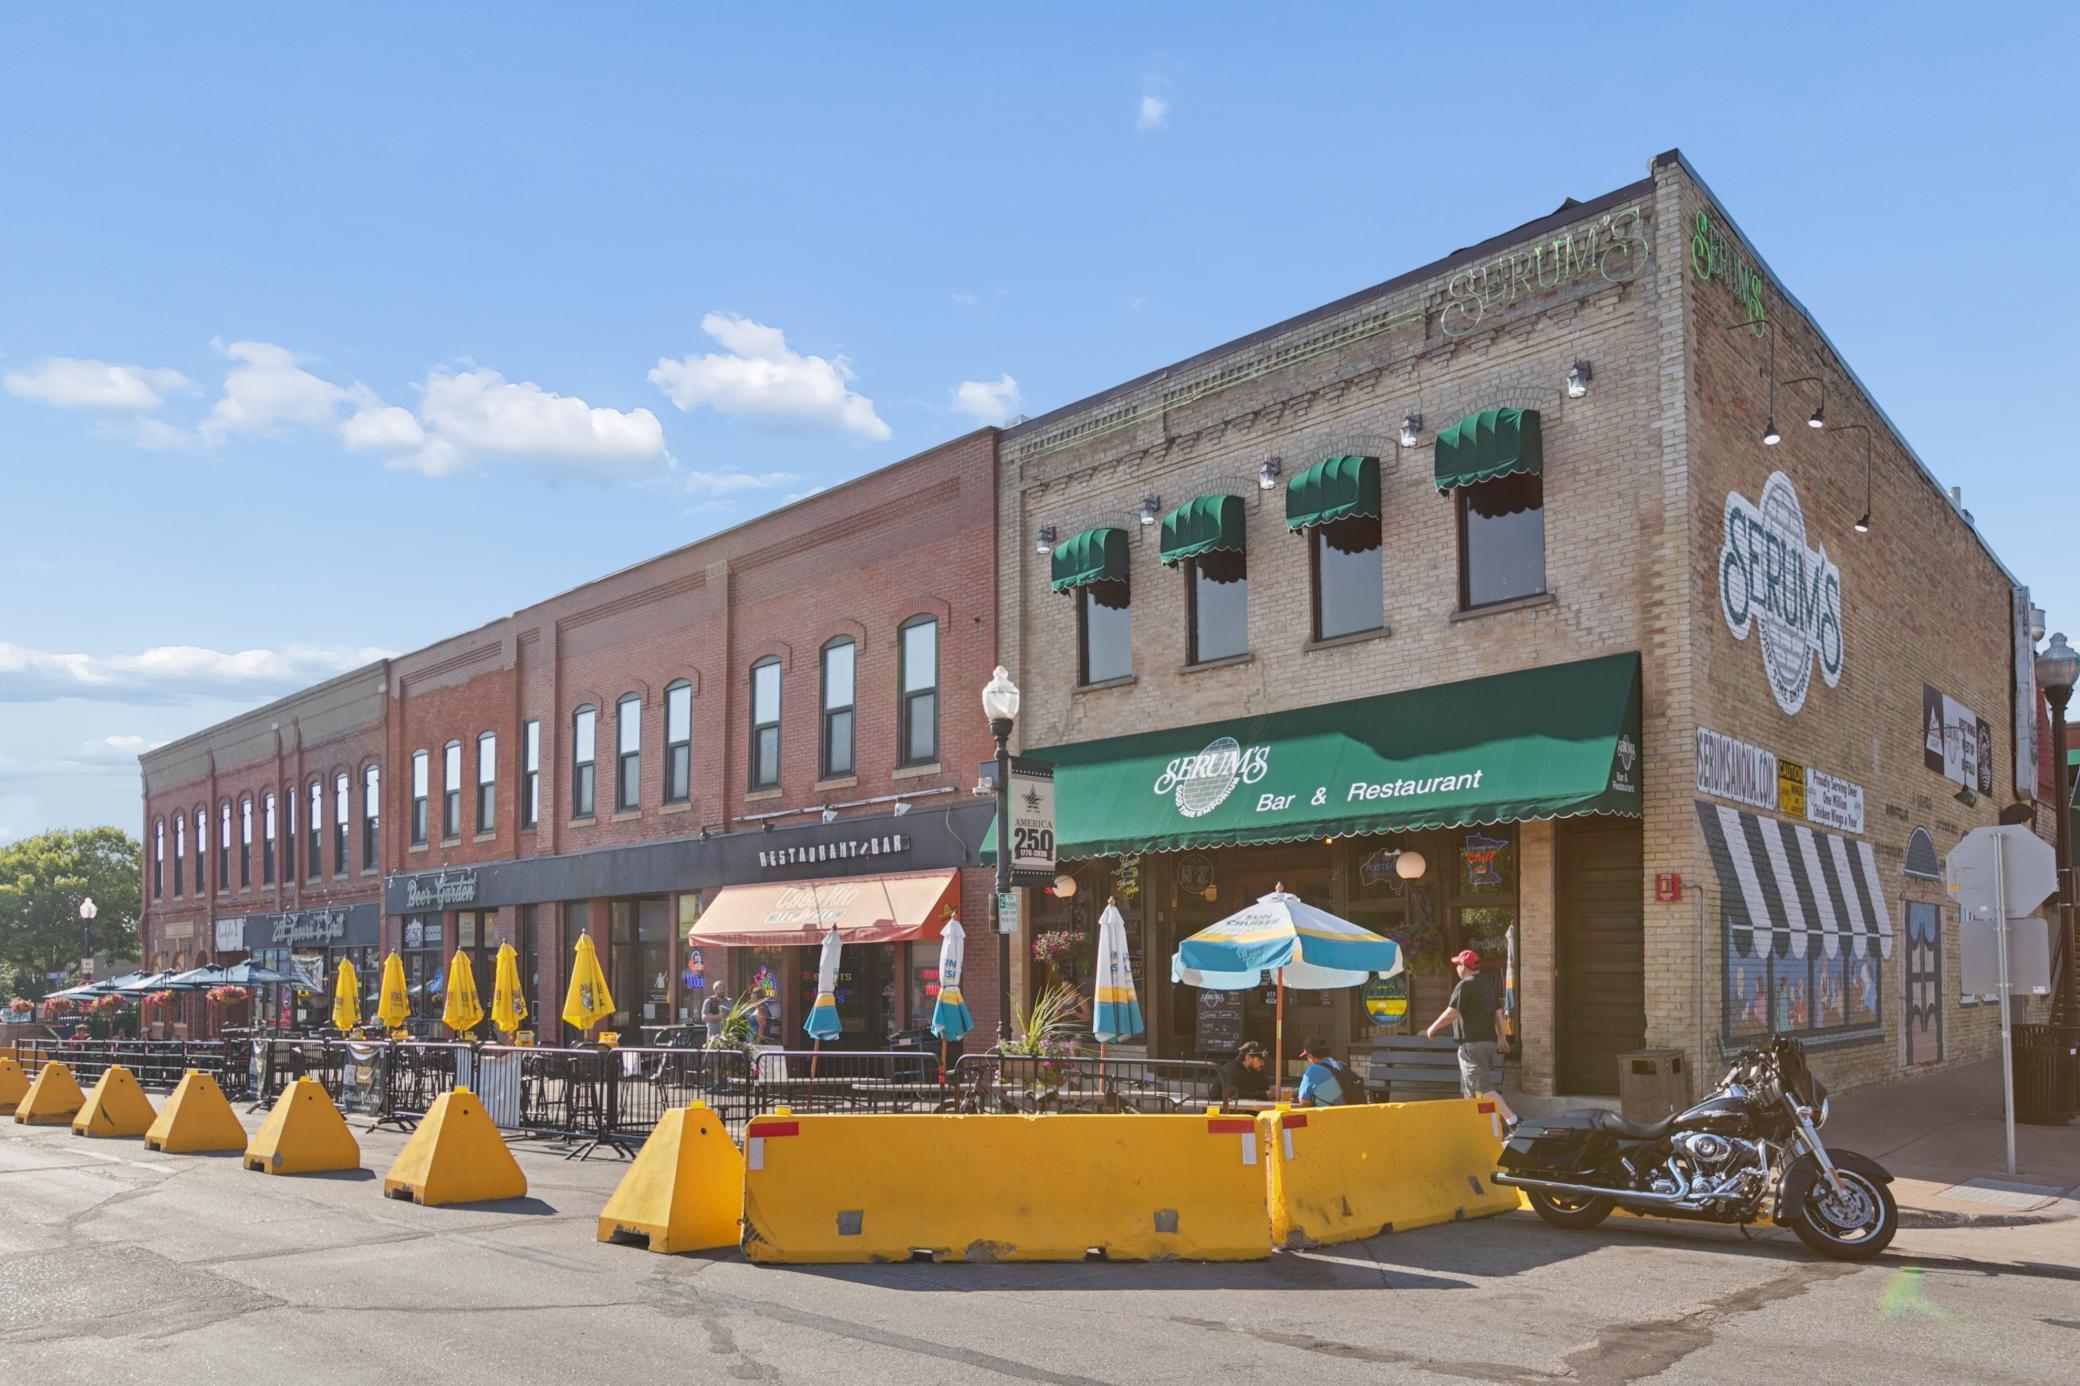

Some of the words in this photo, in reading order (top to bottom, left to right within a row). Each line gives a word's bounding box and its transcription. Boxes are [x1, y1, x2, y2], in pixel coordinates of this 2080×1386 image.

[1441, 208, 1647, 337] SERUM'S
[1692, 210, 1765, 338] SERUM'S
[1723, 505, 1840, 675] SERUM'S
[1154, 746, 1270, 795] SERUM'S
[1256, 793, 1296, 812] Bar
[1310, 787, 1327, 806] &
[1346, 769, 1483, 802] Restaurant
[1813, 770, 1831, 792] Proudly
[1831, 776, 1847, 798] Serving
[1014, 817, 1053, 829] AMERICA
[1014, 827, 1054, 852] 250
[406, 879, 431, 908] Beer
[434, 871, 478, 911] Garden
